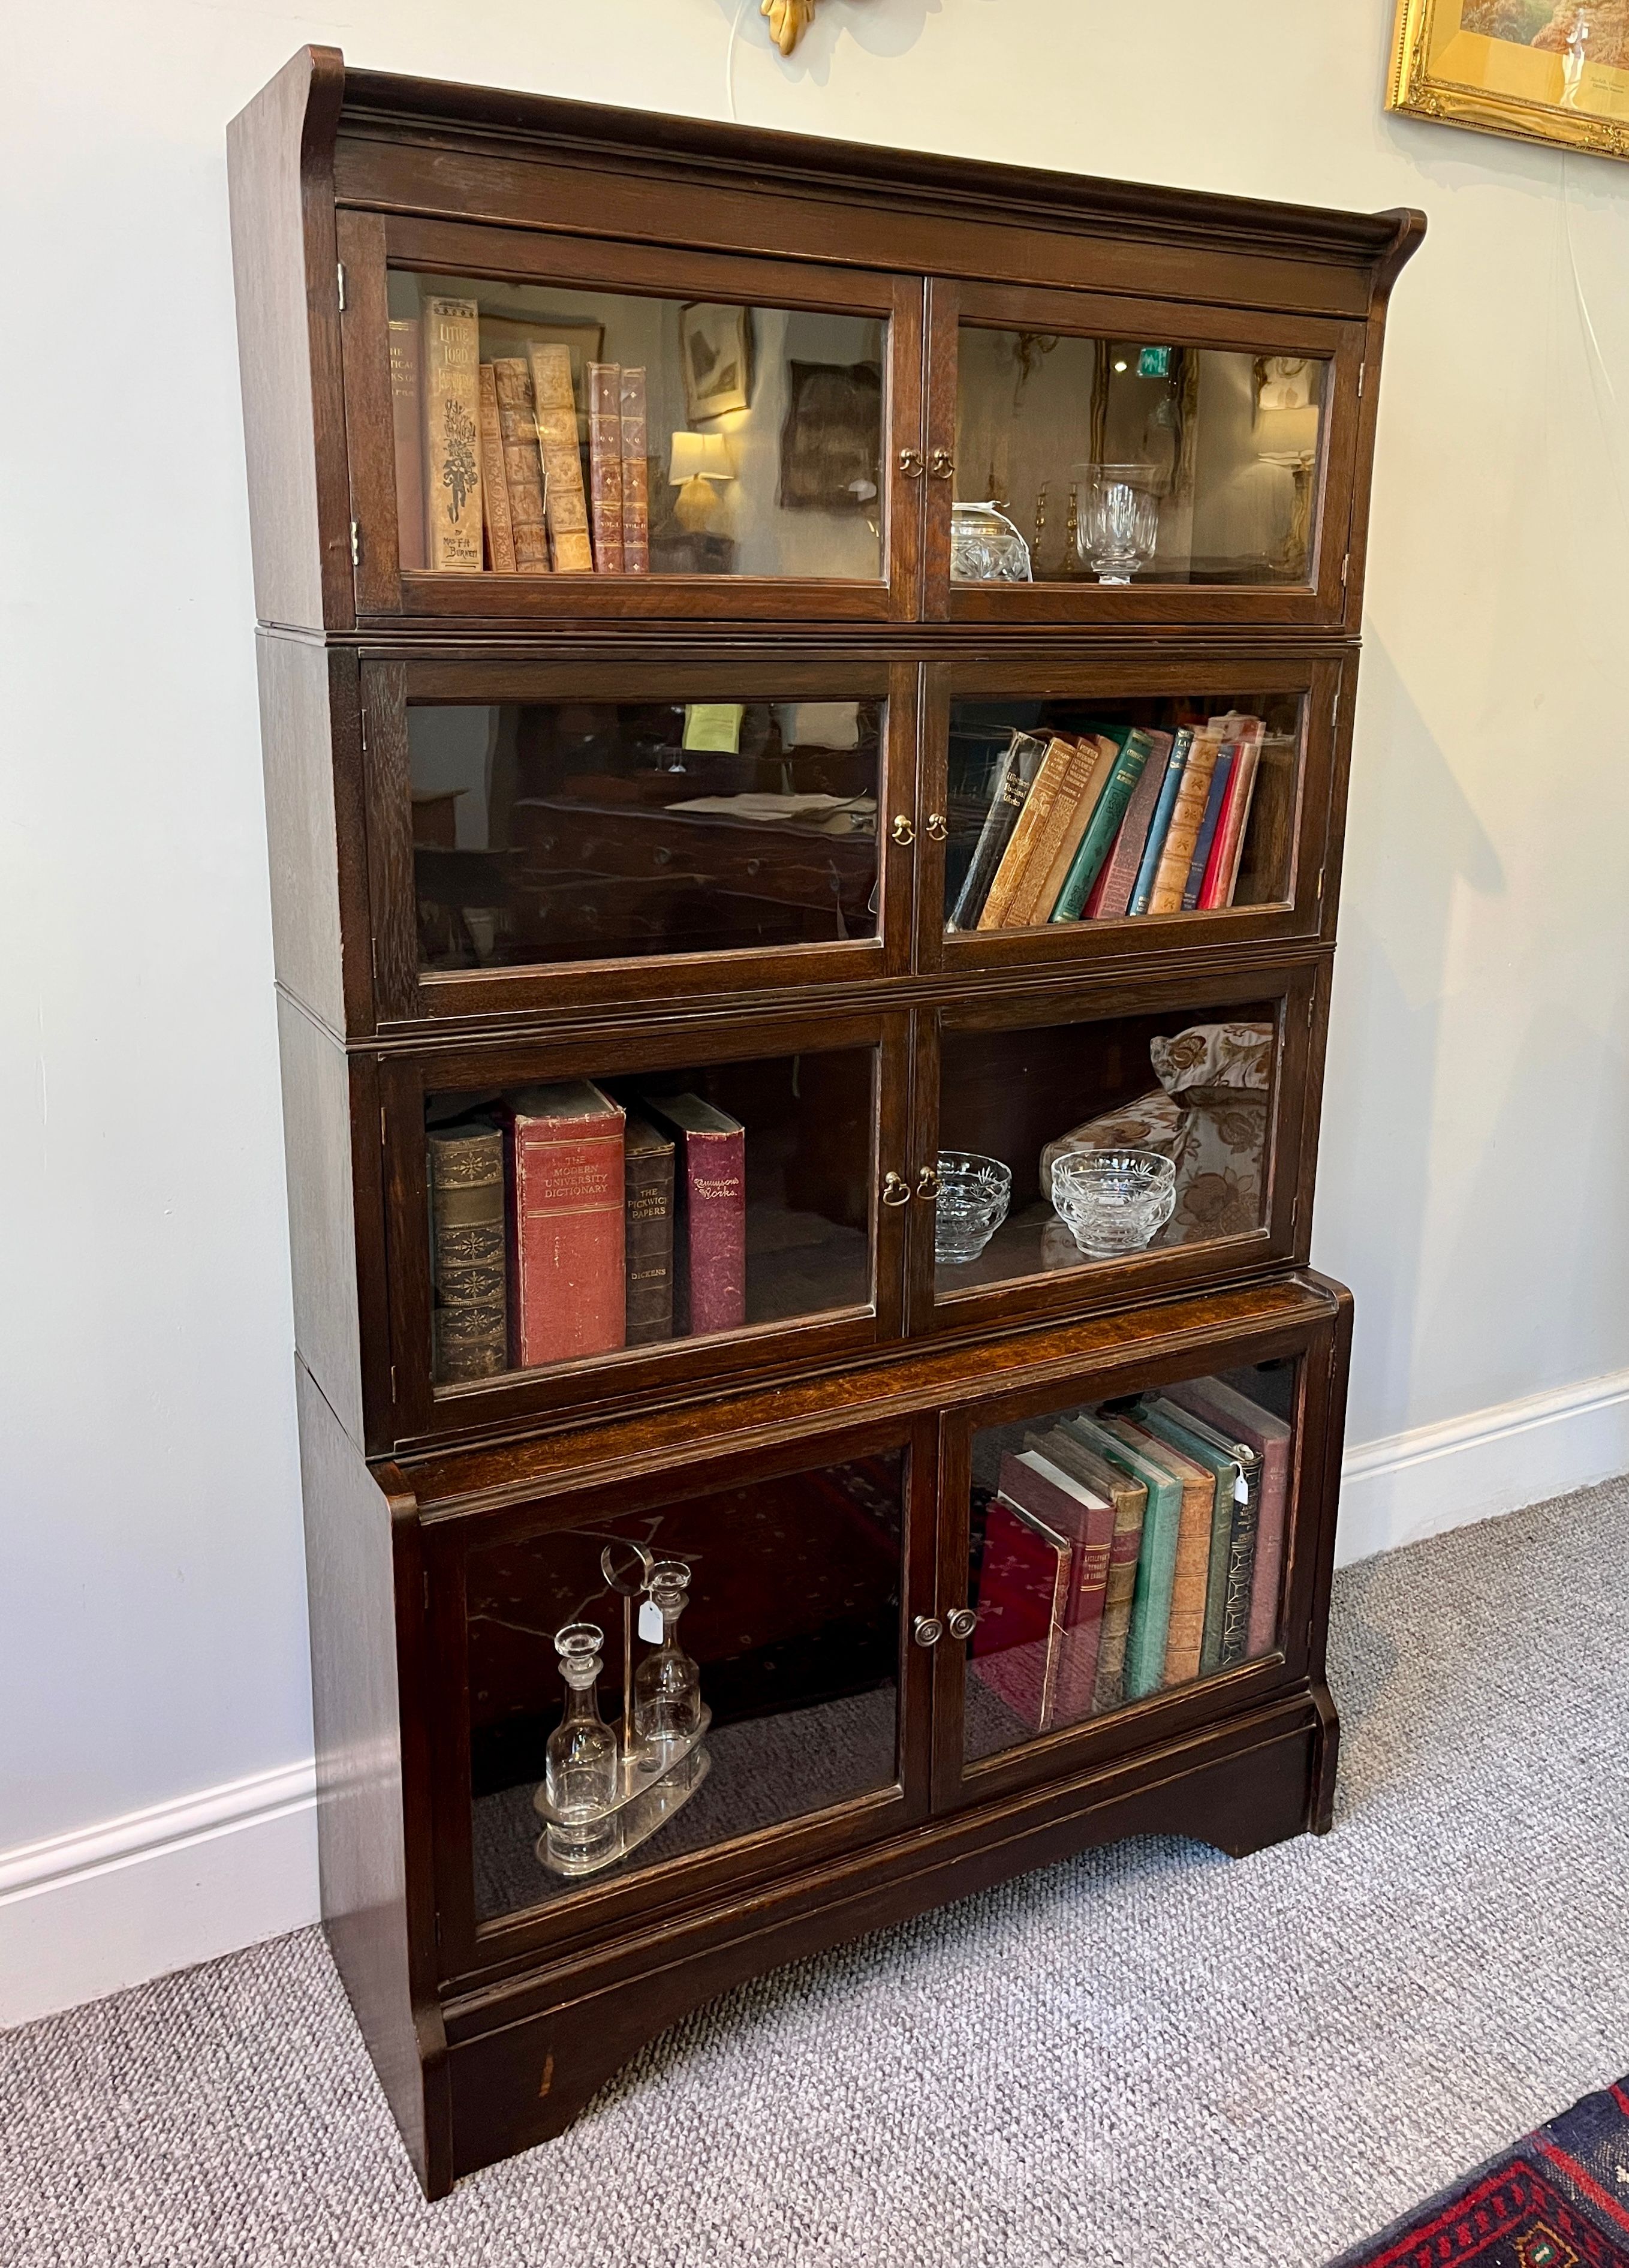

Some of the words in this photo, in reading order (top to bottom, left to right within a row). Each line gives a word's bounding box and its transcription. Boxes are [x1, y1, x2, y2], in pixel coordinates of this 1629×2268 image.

[444, 345, 468, 368] LORD
[565, 1156, 586, 1165] THE
[553, 1165, 599, 1177] MODERN
[544, 1174, 608, 1187] UNIVERSITY
[545, 1184, 608, 1198] DICTIONARY
[640, 1188, 658, 1198] THE
[632, 1206, 666, 1219] PAPERS
[631, 1268, 667, 1280] DICKENS
